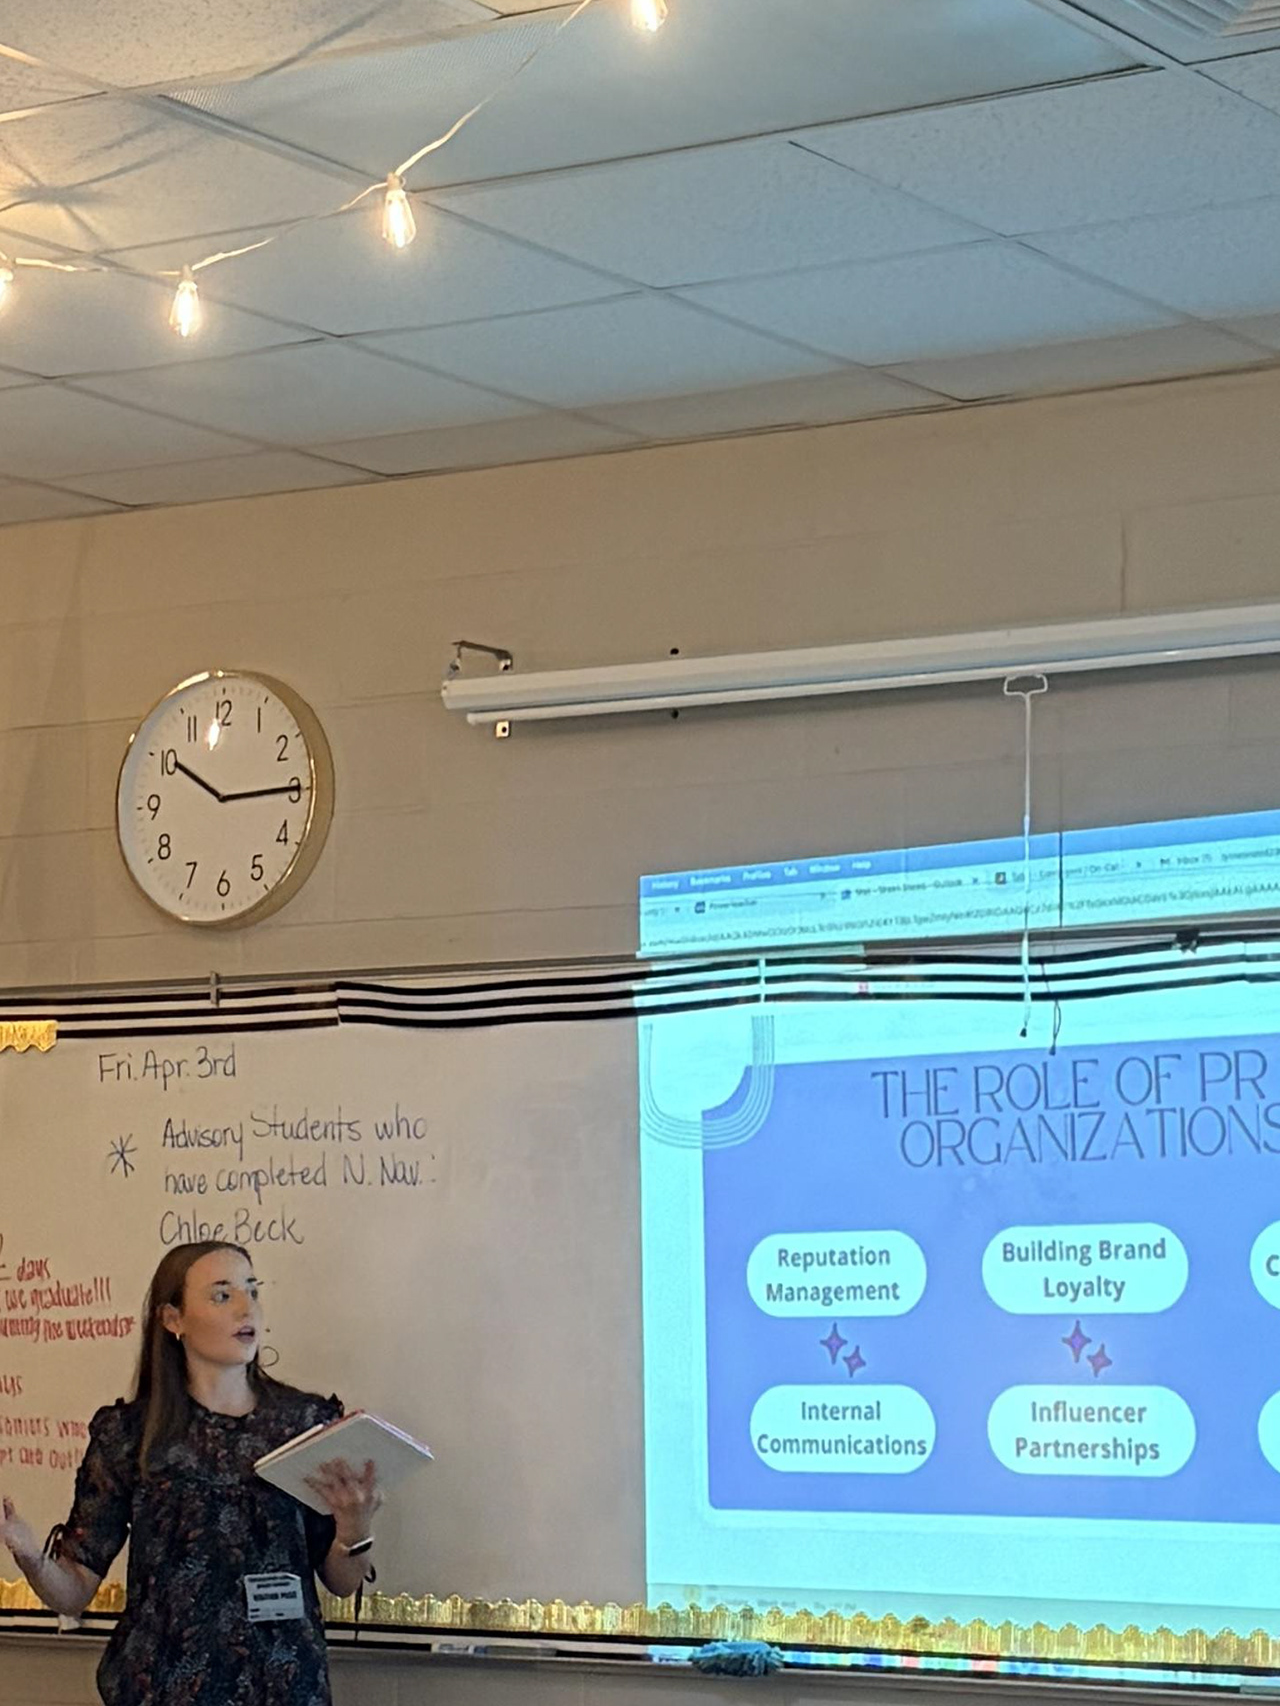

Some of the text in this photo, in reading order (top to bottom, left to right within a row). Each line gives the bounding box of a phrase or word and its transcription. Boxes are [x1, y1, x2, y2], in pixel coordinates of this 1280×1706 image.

[215, 699, 232, 726] 12
[257, 707, 261, 733] 1
[187, 715, 197, 742] 11
[276, 735, 288, 762] 2
[161, 749, 178, 776] 10
[288, 777, 301, 803] 3
[147, 794, 161, 820] 9
[276, 820, 288, 845] 4
[158, 833, 171, 860] 8
[186, 862, 197, 888] 7
[250, 854, 264, 880] 5
[216, 870, 230, 896] 6
[98, 1043, 236, 1091] Fri. Apr. 3rd
[871, 1067, 958, 1118] THE
[973, 1058, 1100, 1113] ROLE
[1115, 1053, 1182, 1106] OF
[1199, 1049, 1267, 1101] PR
[161, 1103, 427, 1161] Advisory Students who
[164, 1167, 208, 1195] have
[216, 1152, 327, 1205] completed
[160, 1209, 228, 1244] Chloe
[777, 1245, 892, 1272] Reputation
[1002, 1237, 1166, 1266] Building Brand
[17, 1257, 51, 1282] days
[765, 1282, 900, 1306] Management
[1043, 1275, 1126, 1303] Loyalty
[801, 1400, 882, 1421] Internal
[1030, 1401, 1147, 1424] Influencer
[756, 1433, 928, 1456] Communications
[1015, 1436, 1160, 1466] Partnerships
